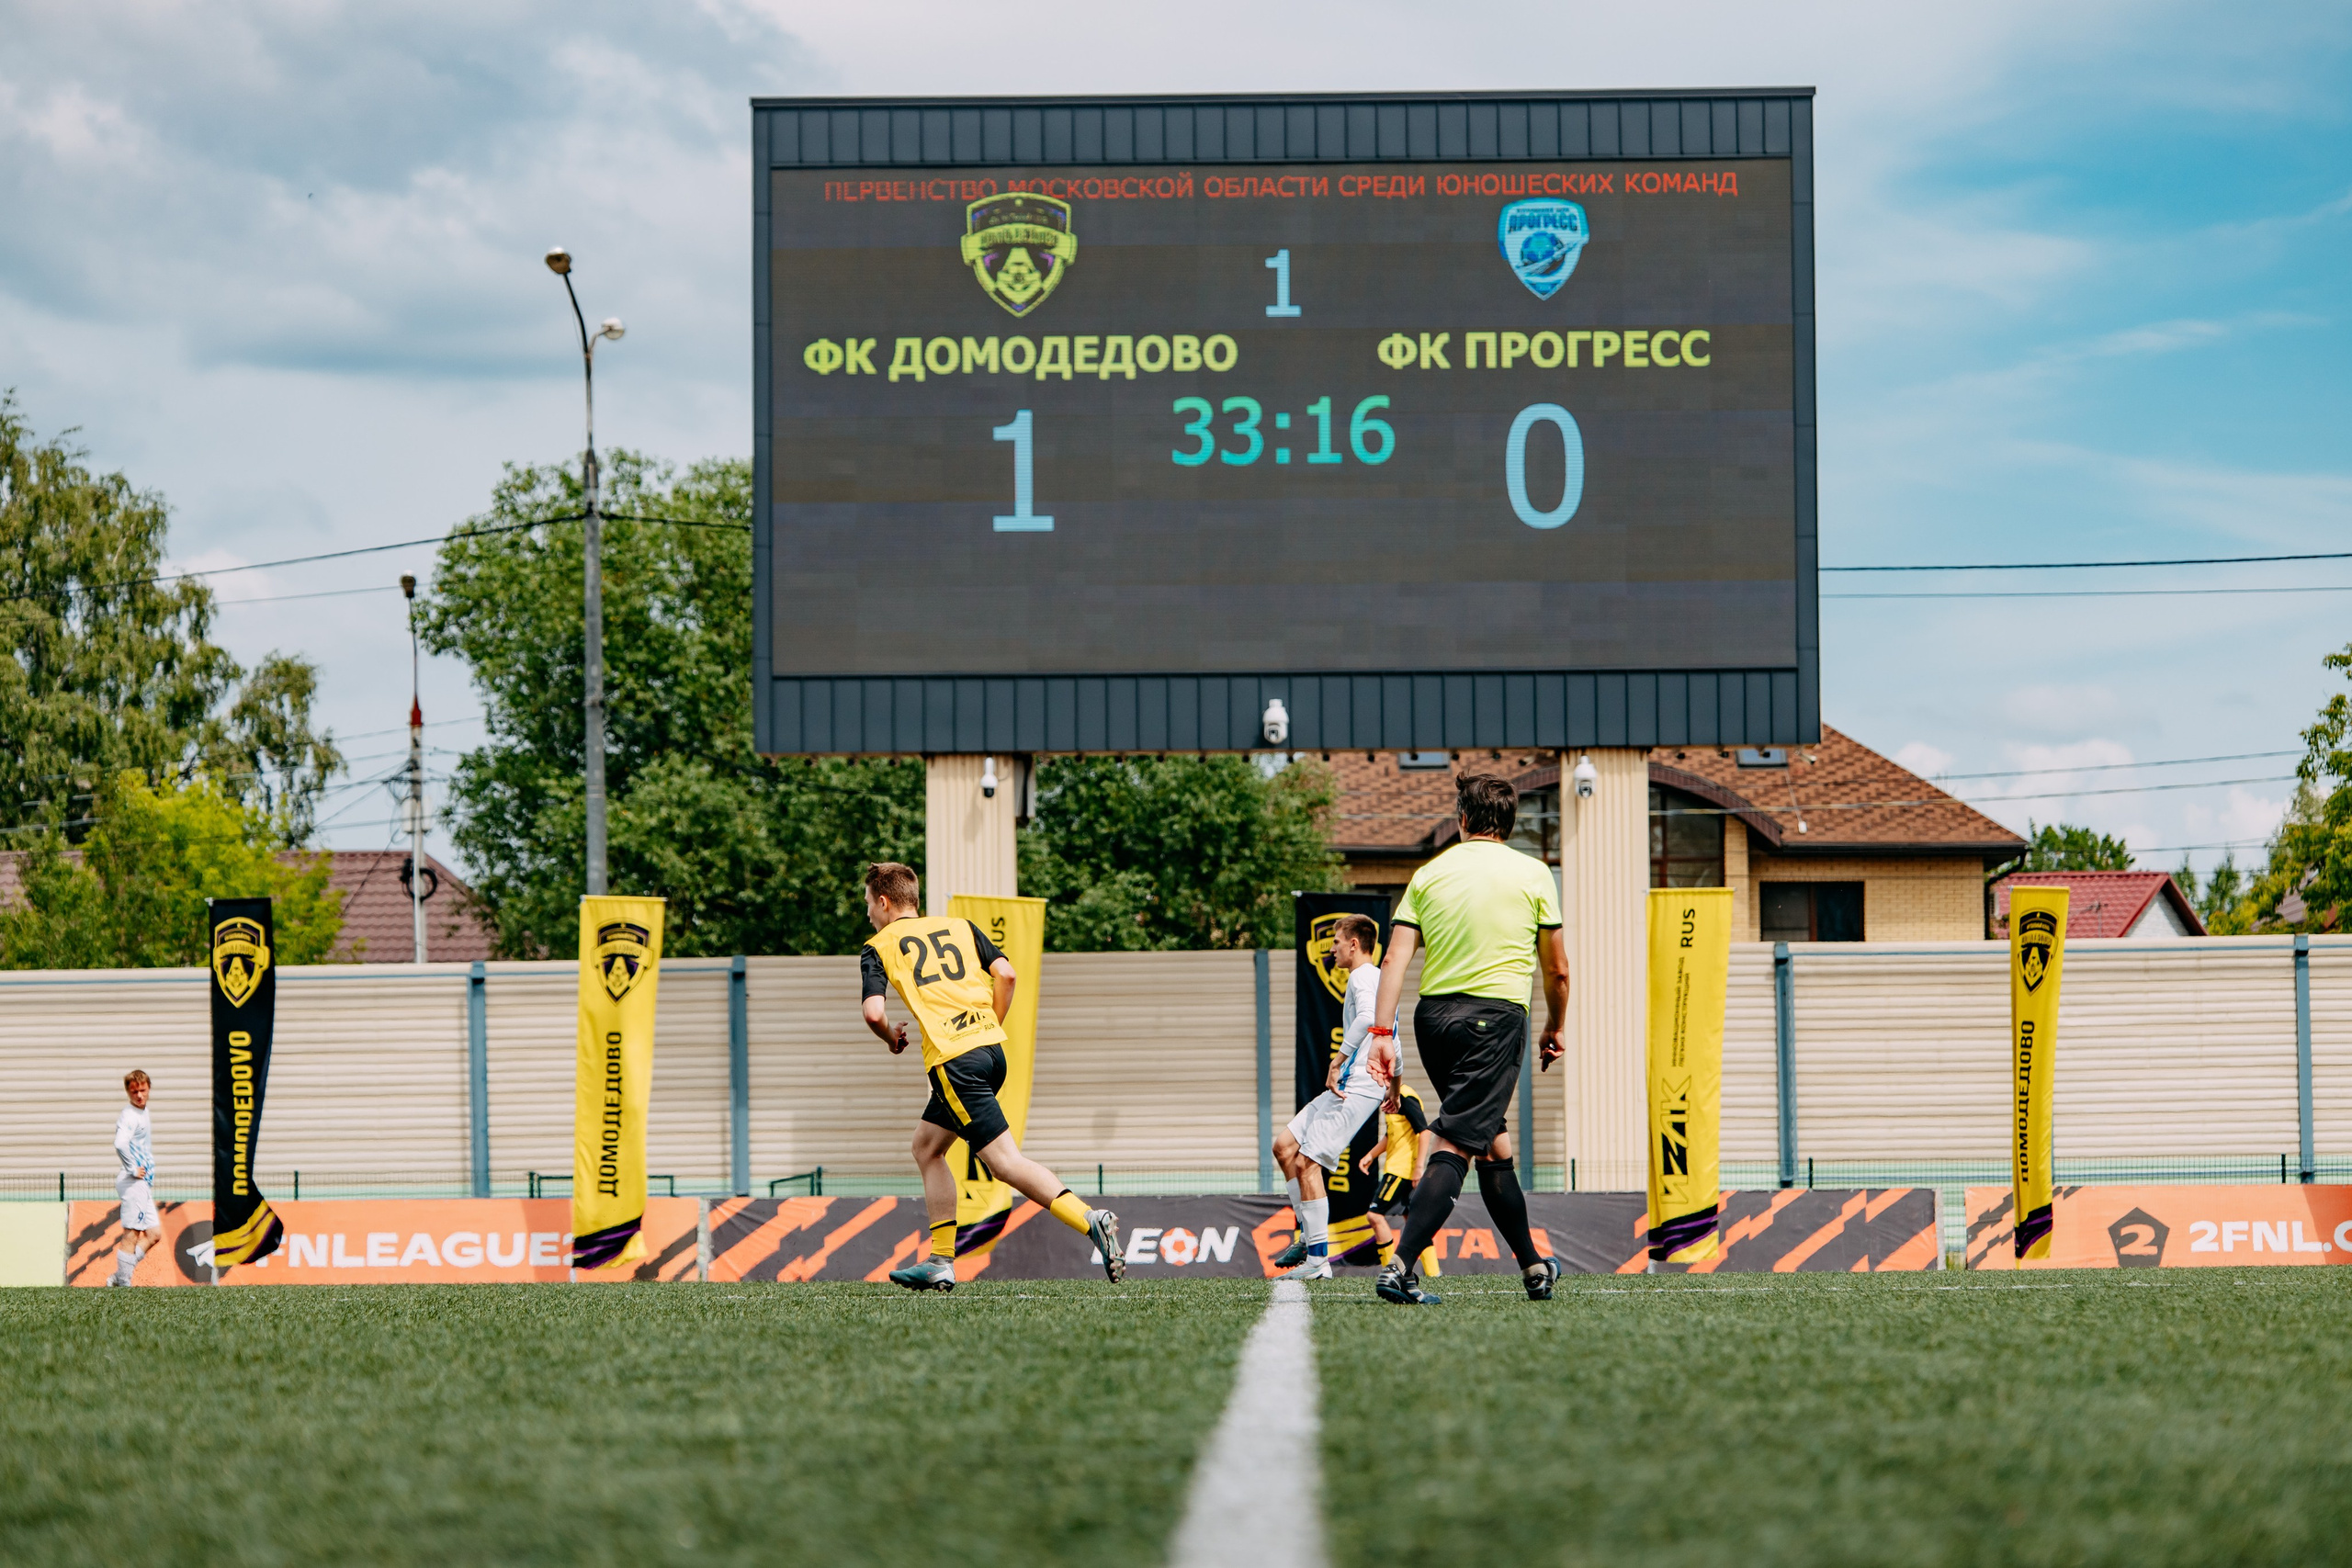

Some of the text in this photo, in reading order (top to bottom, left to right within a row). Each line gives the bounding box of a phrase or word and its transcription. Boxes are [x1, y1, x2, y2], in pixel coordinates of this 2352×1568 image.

[825, 172, 1739, 202] ПЕРВЕНСТВО МОСКОВСКОЙ ОБЛАСТИ СРЕДИ ЮНОШЕСКИХ КОМАНД
[1264, 249, 1303, 318] 1
[803, 333, 1238, 382] ФК ДОМОДЕДОВО
[1377, 330, 1712, 369] ФК ПРОГРЕСС
[1171, 395, 1396, 467] 33:16
[992, 410, 1055, 532] 1
[1505, 402, 1585, 530] 0
[899, 929, 966, 987] 25
[1680, 908, 1696, 949] RUS
[598, 1032, 623, 1197] ДОМОДЕДОВО
